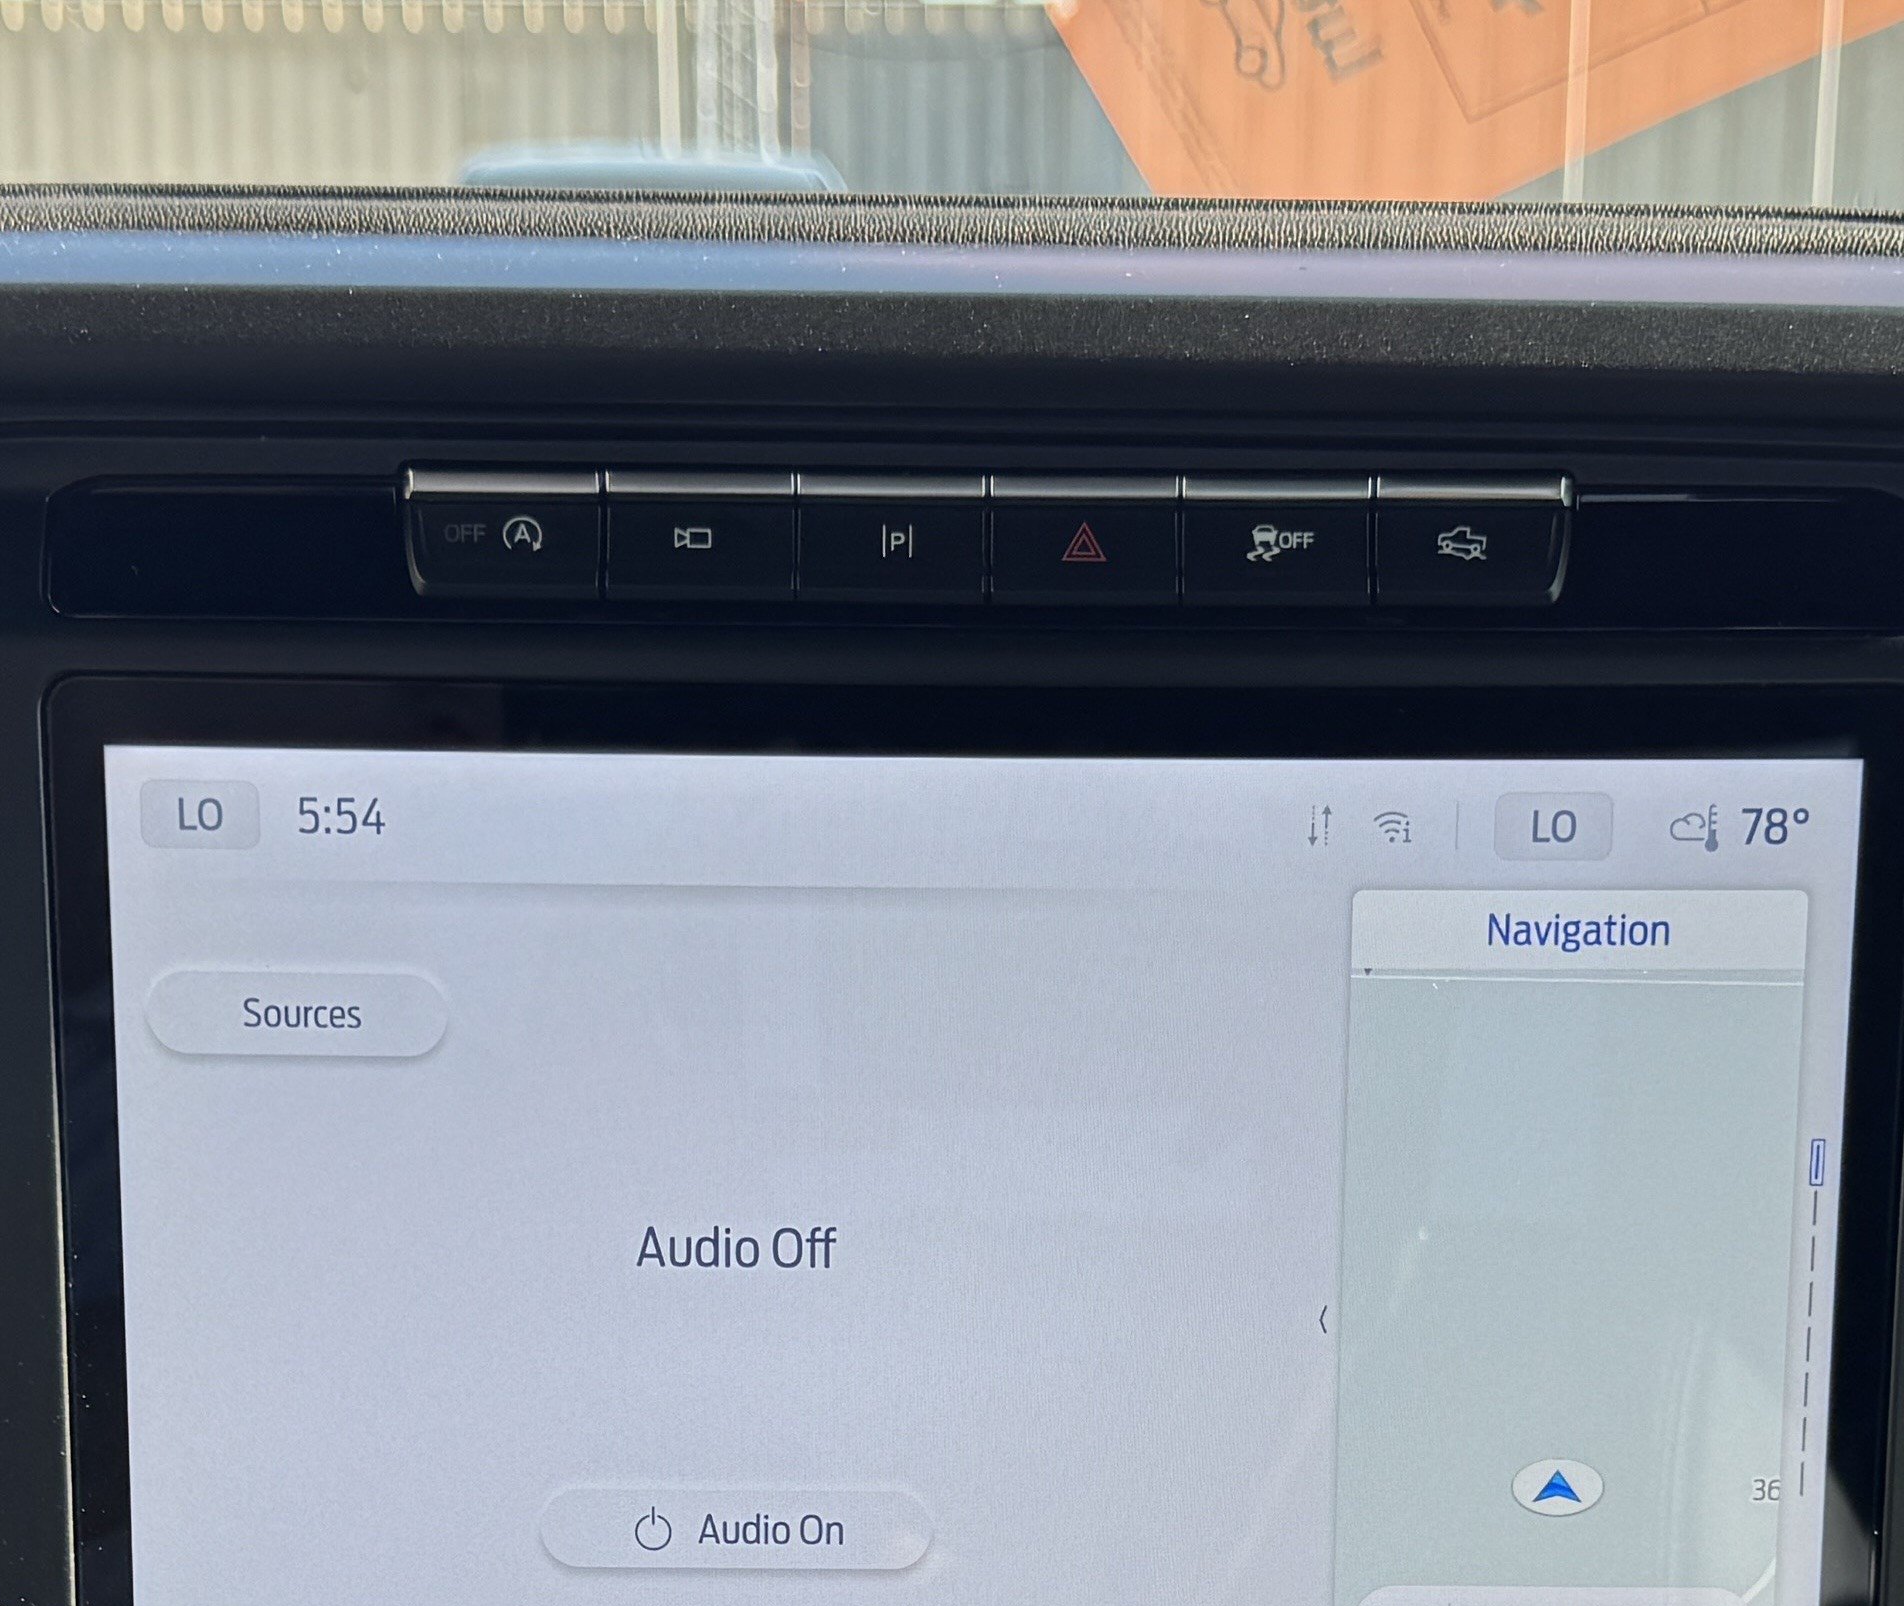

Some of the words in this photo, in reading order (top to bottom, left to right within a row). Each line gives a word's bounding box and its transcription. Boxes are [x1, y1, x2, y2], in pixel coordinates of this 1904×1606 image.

[445, 524, 487, 543] OFF
[1279, 532, 1315, 549] OFF
[178, 797, 224, 832] LO
[298, 796, 386, 835] 5:54
[1531, 809, 1577, 843] LO
[1741, 808, 1810, 845] 78°
[1487, 913, 1670, 952] Navigation
[243, 998, 362, 1029] Sources
[636, 1226, 760, 1267] Audio
[772, 1227, 837, 1269] Off
[698, 1513, 791, 1545] Audio
[799, 1515, 844, 1545] On
